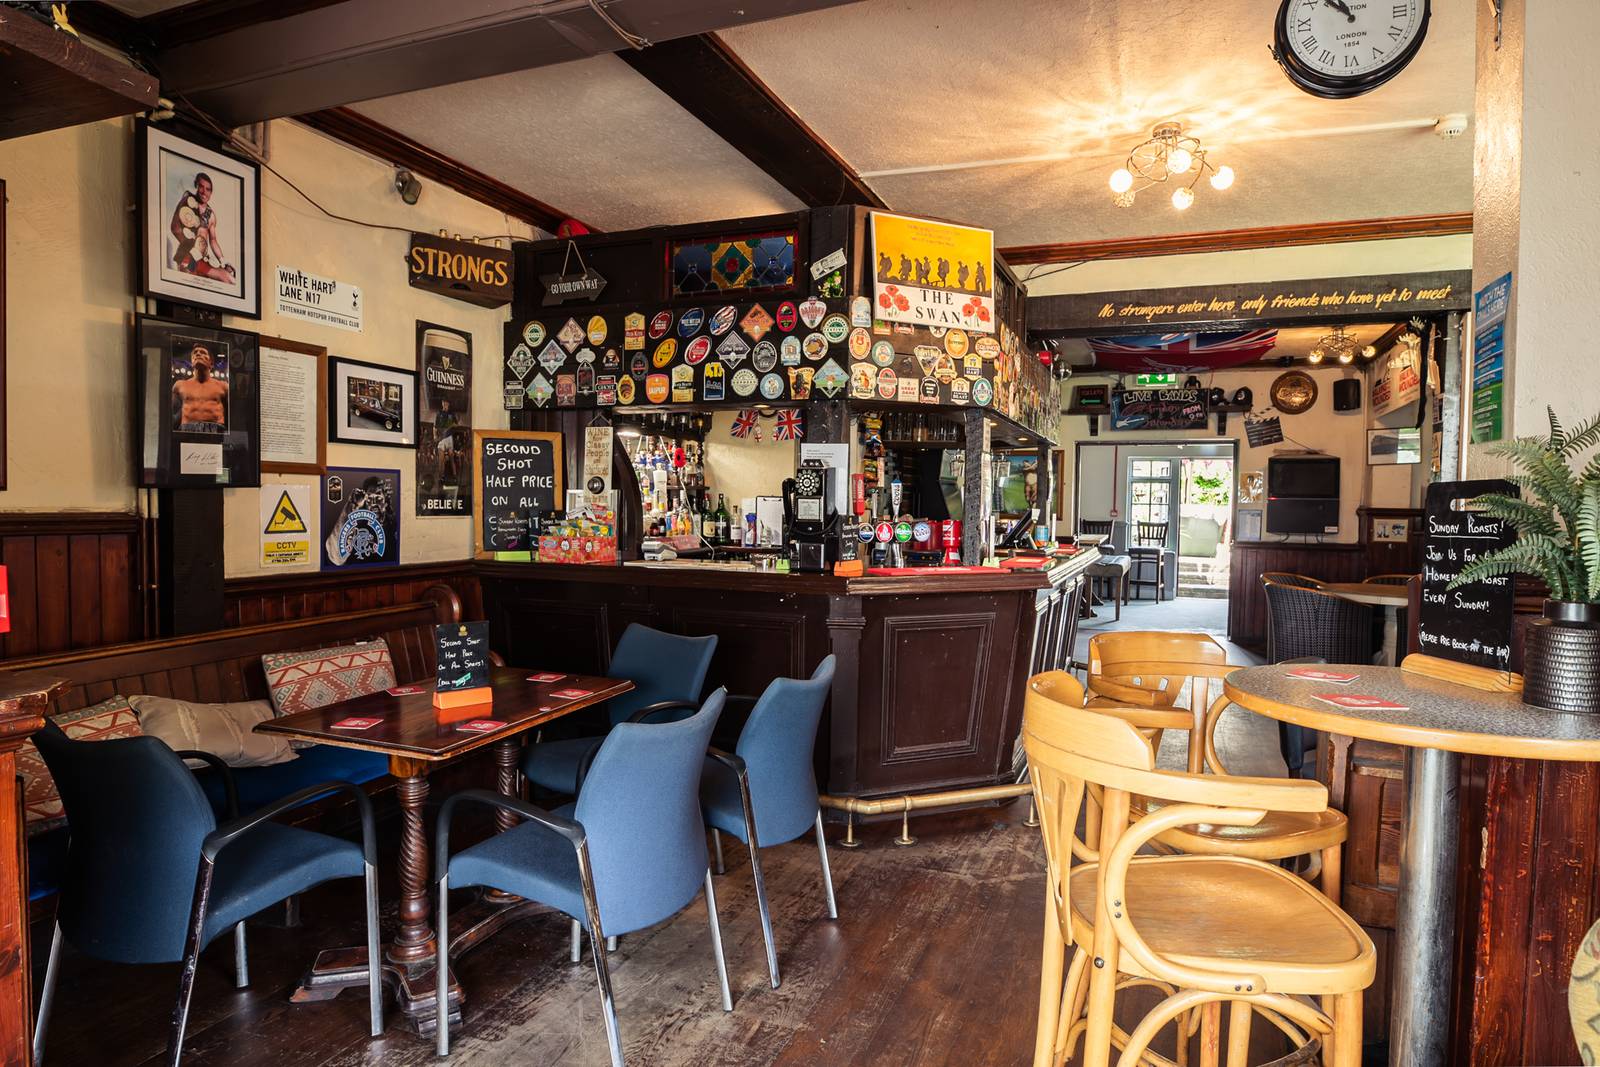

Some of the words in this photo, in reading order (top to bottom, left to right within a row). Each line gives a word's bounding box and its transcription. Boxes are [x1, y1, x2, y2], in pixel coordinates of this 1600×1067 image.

[1336, 31, 1367, 40] LONDON
[1344, 40, 1360, 48] 1854
[411, 247, 509, 287] STRONGS
[279, 270, 308, 289] WHITE
[311, 278, 333, 295] HART
[550, 283, 559, 294] GO
[559, 282, 572, 293] YOUR
[572, 280, 585, 292] OWN
[585, 278, 598, 290] WAY
[279, 284, 302, 301] LANE
[305, 291, 321, 304] N17
[920, 289, 954, 305] THE
[1098, 303, 1115, 318] No
[1118, 303, 1174, 320] strangers
[1177, 299, 1207, 314] enter
[1241, 294, 1269, 315] only
[1271, 292, 1319, 308] friends
[1320, 290, 1344, 306] who
[1346, 290, 1374, 305] have
[1375, 288, 1397, 309] yet
[1398, 287, 1413, 302] to
[1416, 284, 1452, 300] meet
[279, 304, 306, 315] TOTTENHAM
[307, 311, 327, 321] HOTSPUR
[327, 315, 348, 326] FOOTBALL
[348, 320, 360, 328] CLUB
[915, 306, 960, 324] SWAN
[426, 366, 464, 387] GUINNESS
[1123, 389, 1152, 404] LIVE
[1159, 388, 1198, 402] BANDS
[1182, 404, 1201, 415] FROM
[586, 428, 610, 437] WINE
[486, 443, 541, 456] SECOND
[497, 458, 534, 471] SHOT
[486, 475, 516, 488] HALF
[521, 475, 553, 489] PRICE
[491, 496, 509, 506] ON
[519, 497, 539, 508] ALL
[350, 511, 375, 520] FOOTBALL
[375, 525, 384, 544] CLUB
[276, 541, 297, 549] CCTV
